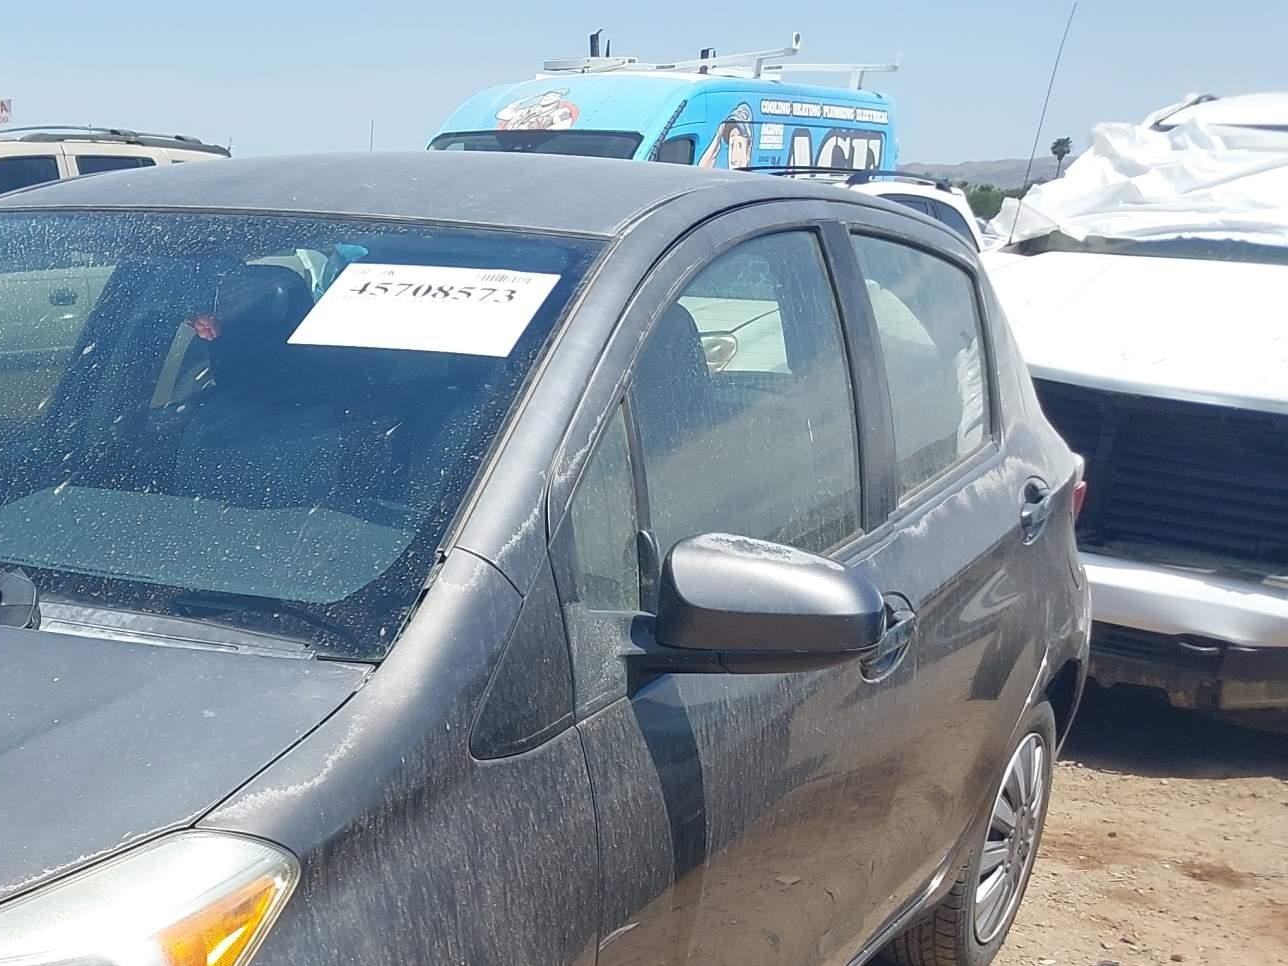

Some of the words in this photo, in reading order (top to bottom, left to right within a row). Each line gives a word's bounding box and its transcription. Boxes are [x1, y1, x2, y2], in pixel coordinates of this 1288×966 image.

[761, 100, 791, 115] COOLING
[792, 103, 821, 118] HEATING
[349, 280, 518, 303] 45708573
